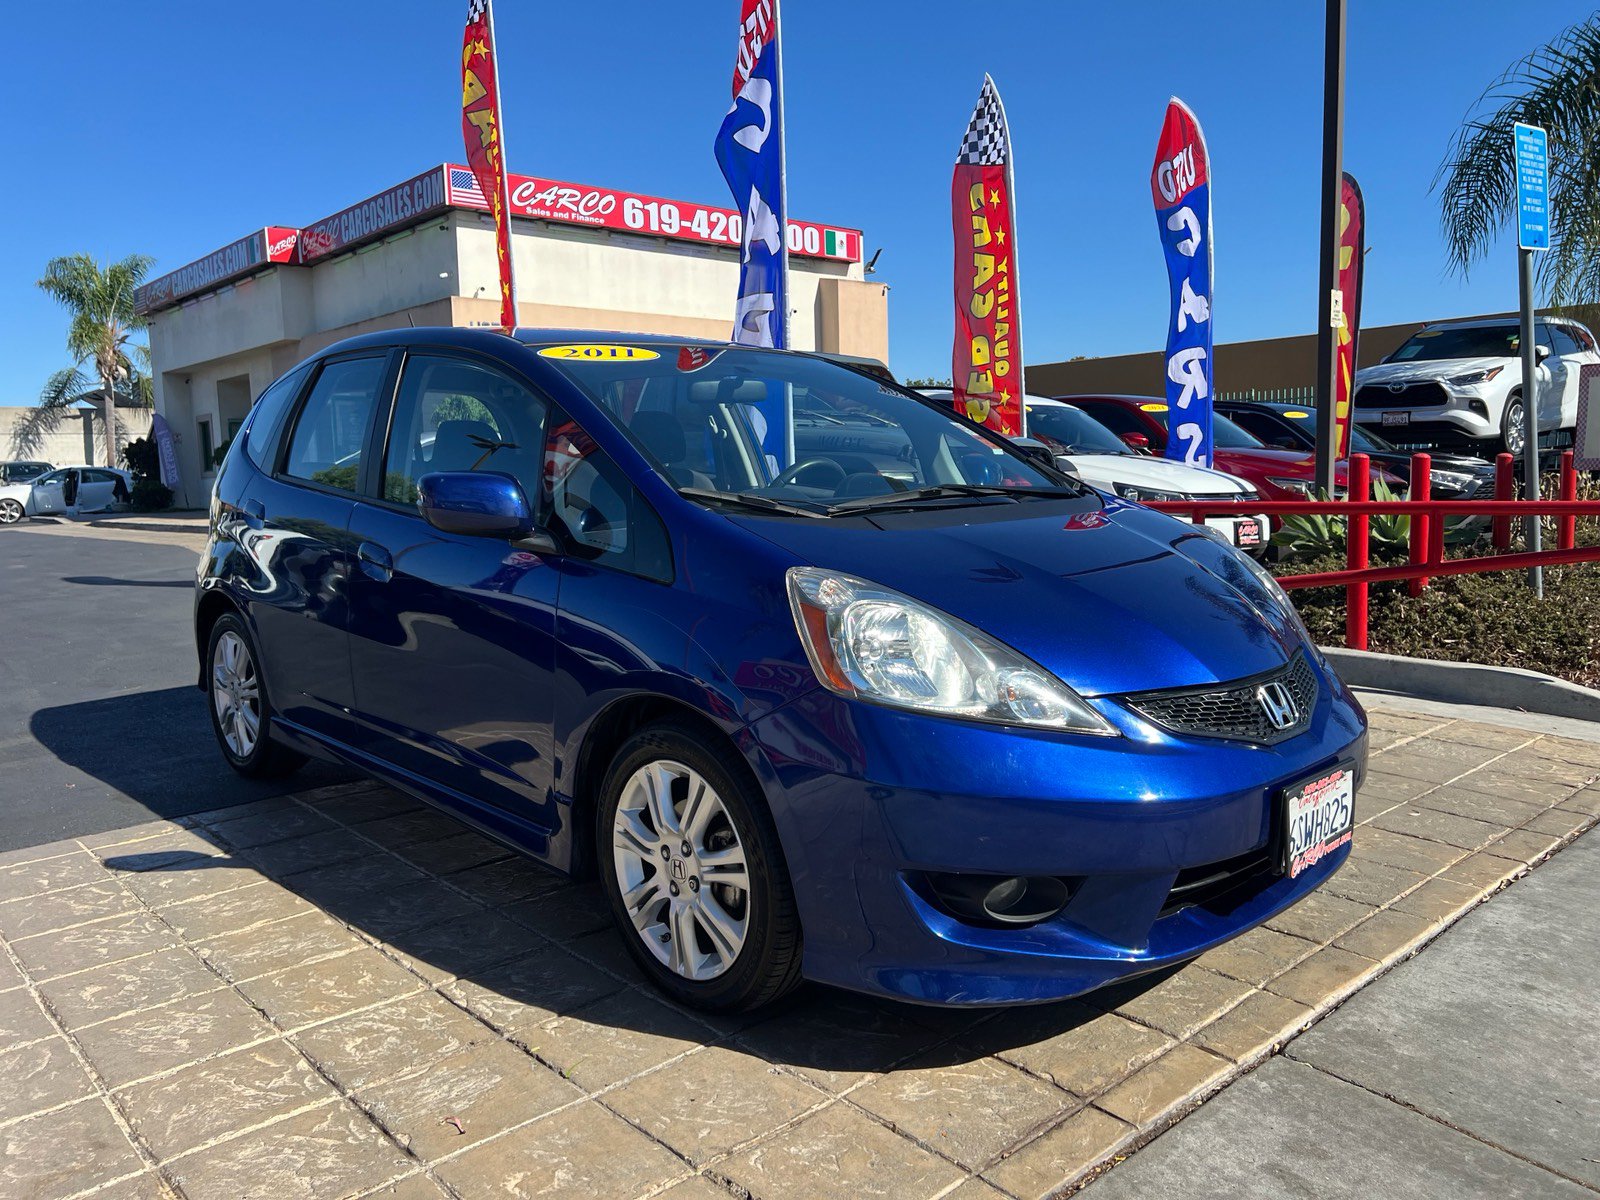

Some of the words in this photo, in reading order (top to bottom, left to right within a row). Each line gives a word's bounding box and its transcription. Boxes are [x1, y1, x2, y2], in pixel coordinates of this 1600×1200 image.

[341, 170, 445, 243] CARCOSALES.COM
[511, 181, 617, 216] CARCO
[525, 206, 551, 217] Sales
[552, 211, 570, 220] and
[571, 212, 605, 225] Finance
[269, 235, 297, 256] CARCO
[171, 240, 248, 297] CARCOSALES.COM
[561, 348, 635, 358] 2011
